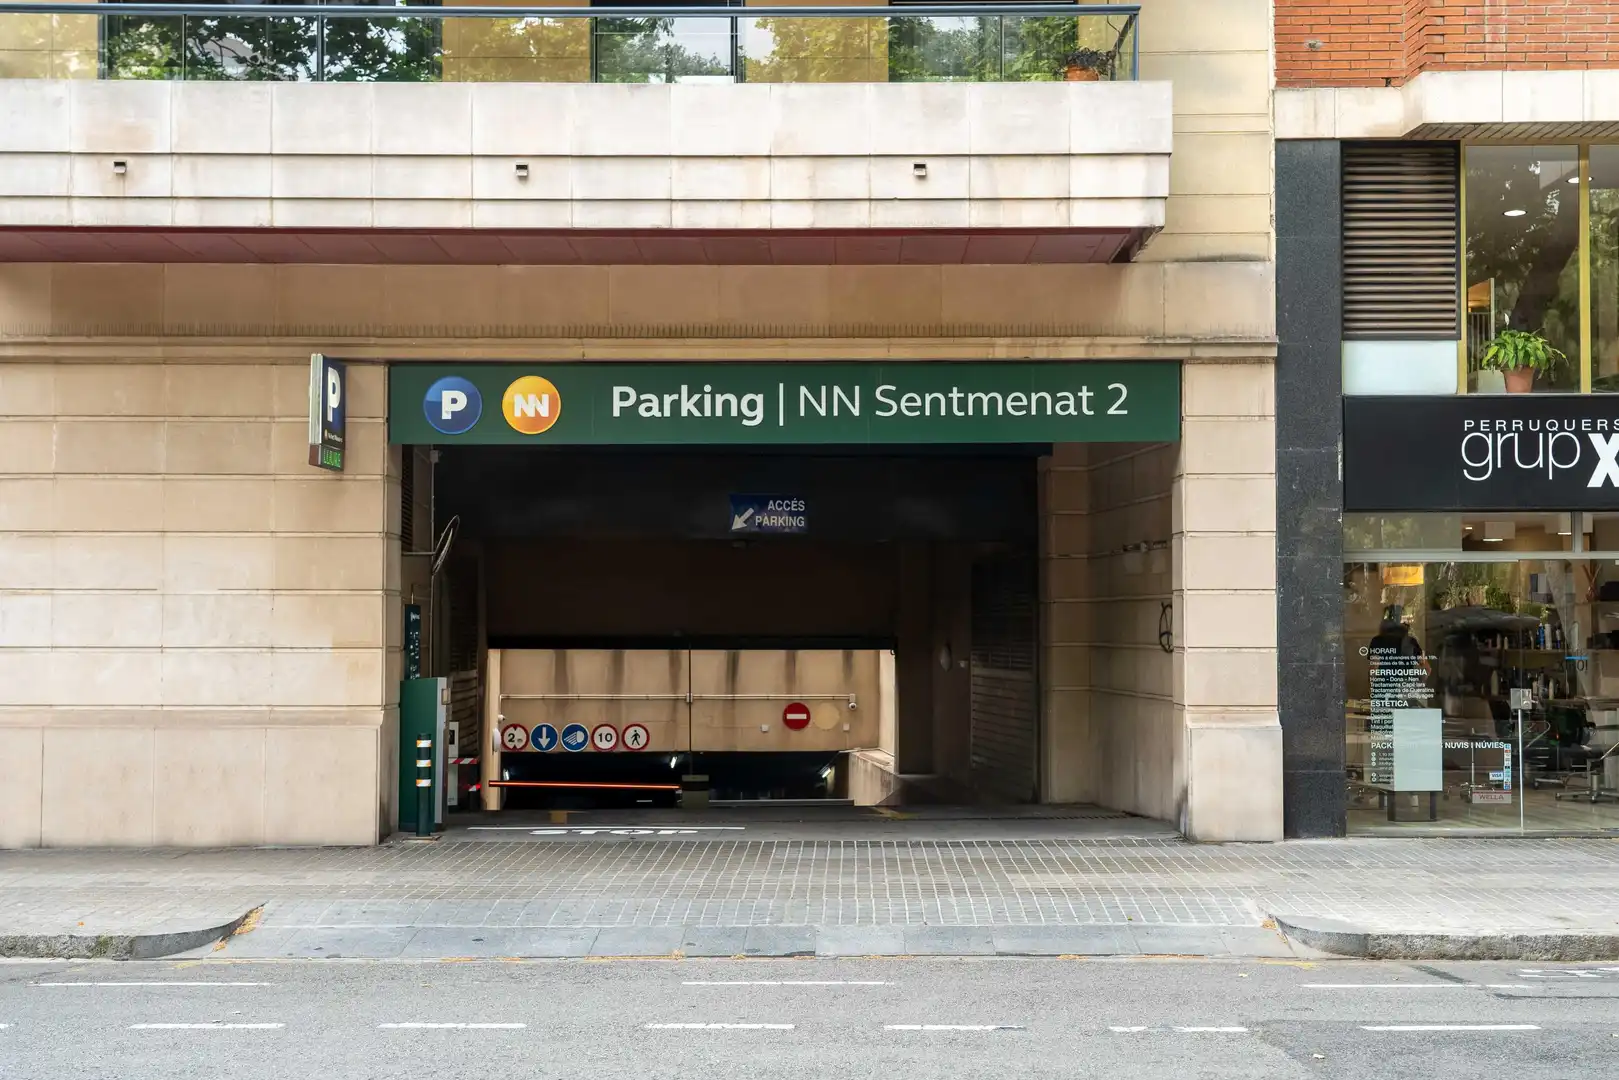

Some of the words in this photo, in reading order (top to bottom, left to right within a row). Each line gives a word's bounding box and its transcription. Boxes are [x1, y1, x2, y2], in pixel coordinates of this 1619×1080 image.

[327, 366, 341, 422] P
[441, 390, 467, 420] P
[514, 393, 549, 417] NN
[612, 384, 764, 426] Parking
[799, 385, 860, 417] NN
[875, 384, 1094, 417] Sentmenat
[1106, 383, 1129, 415] 2
[1461, 432, 1581, 481] grup
[767, 498, 805, 511] ACCÉS
[1369, 668, 1428, 676] PERRUQUERIA
[598, 733, 613, 743] 10
[1475, 740, 1505, 749] NÚVIES
